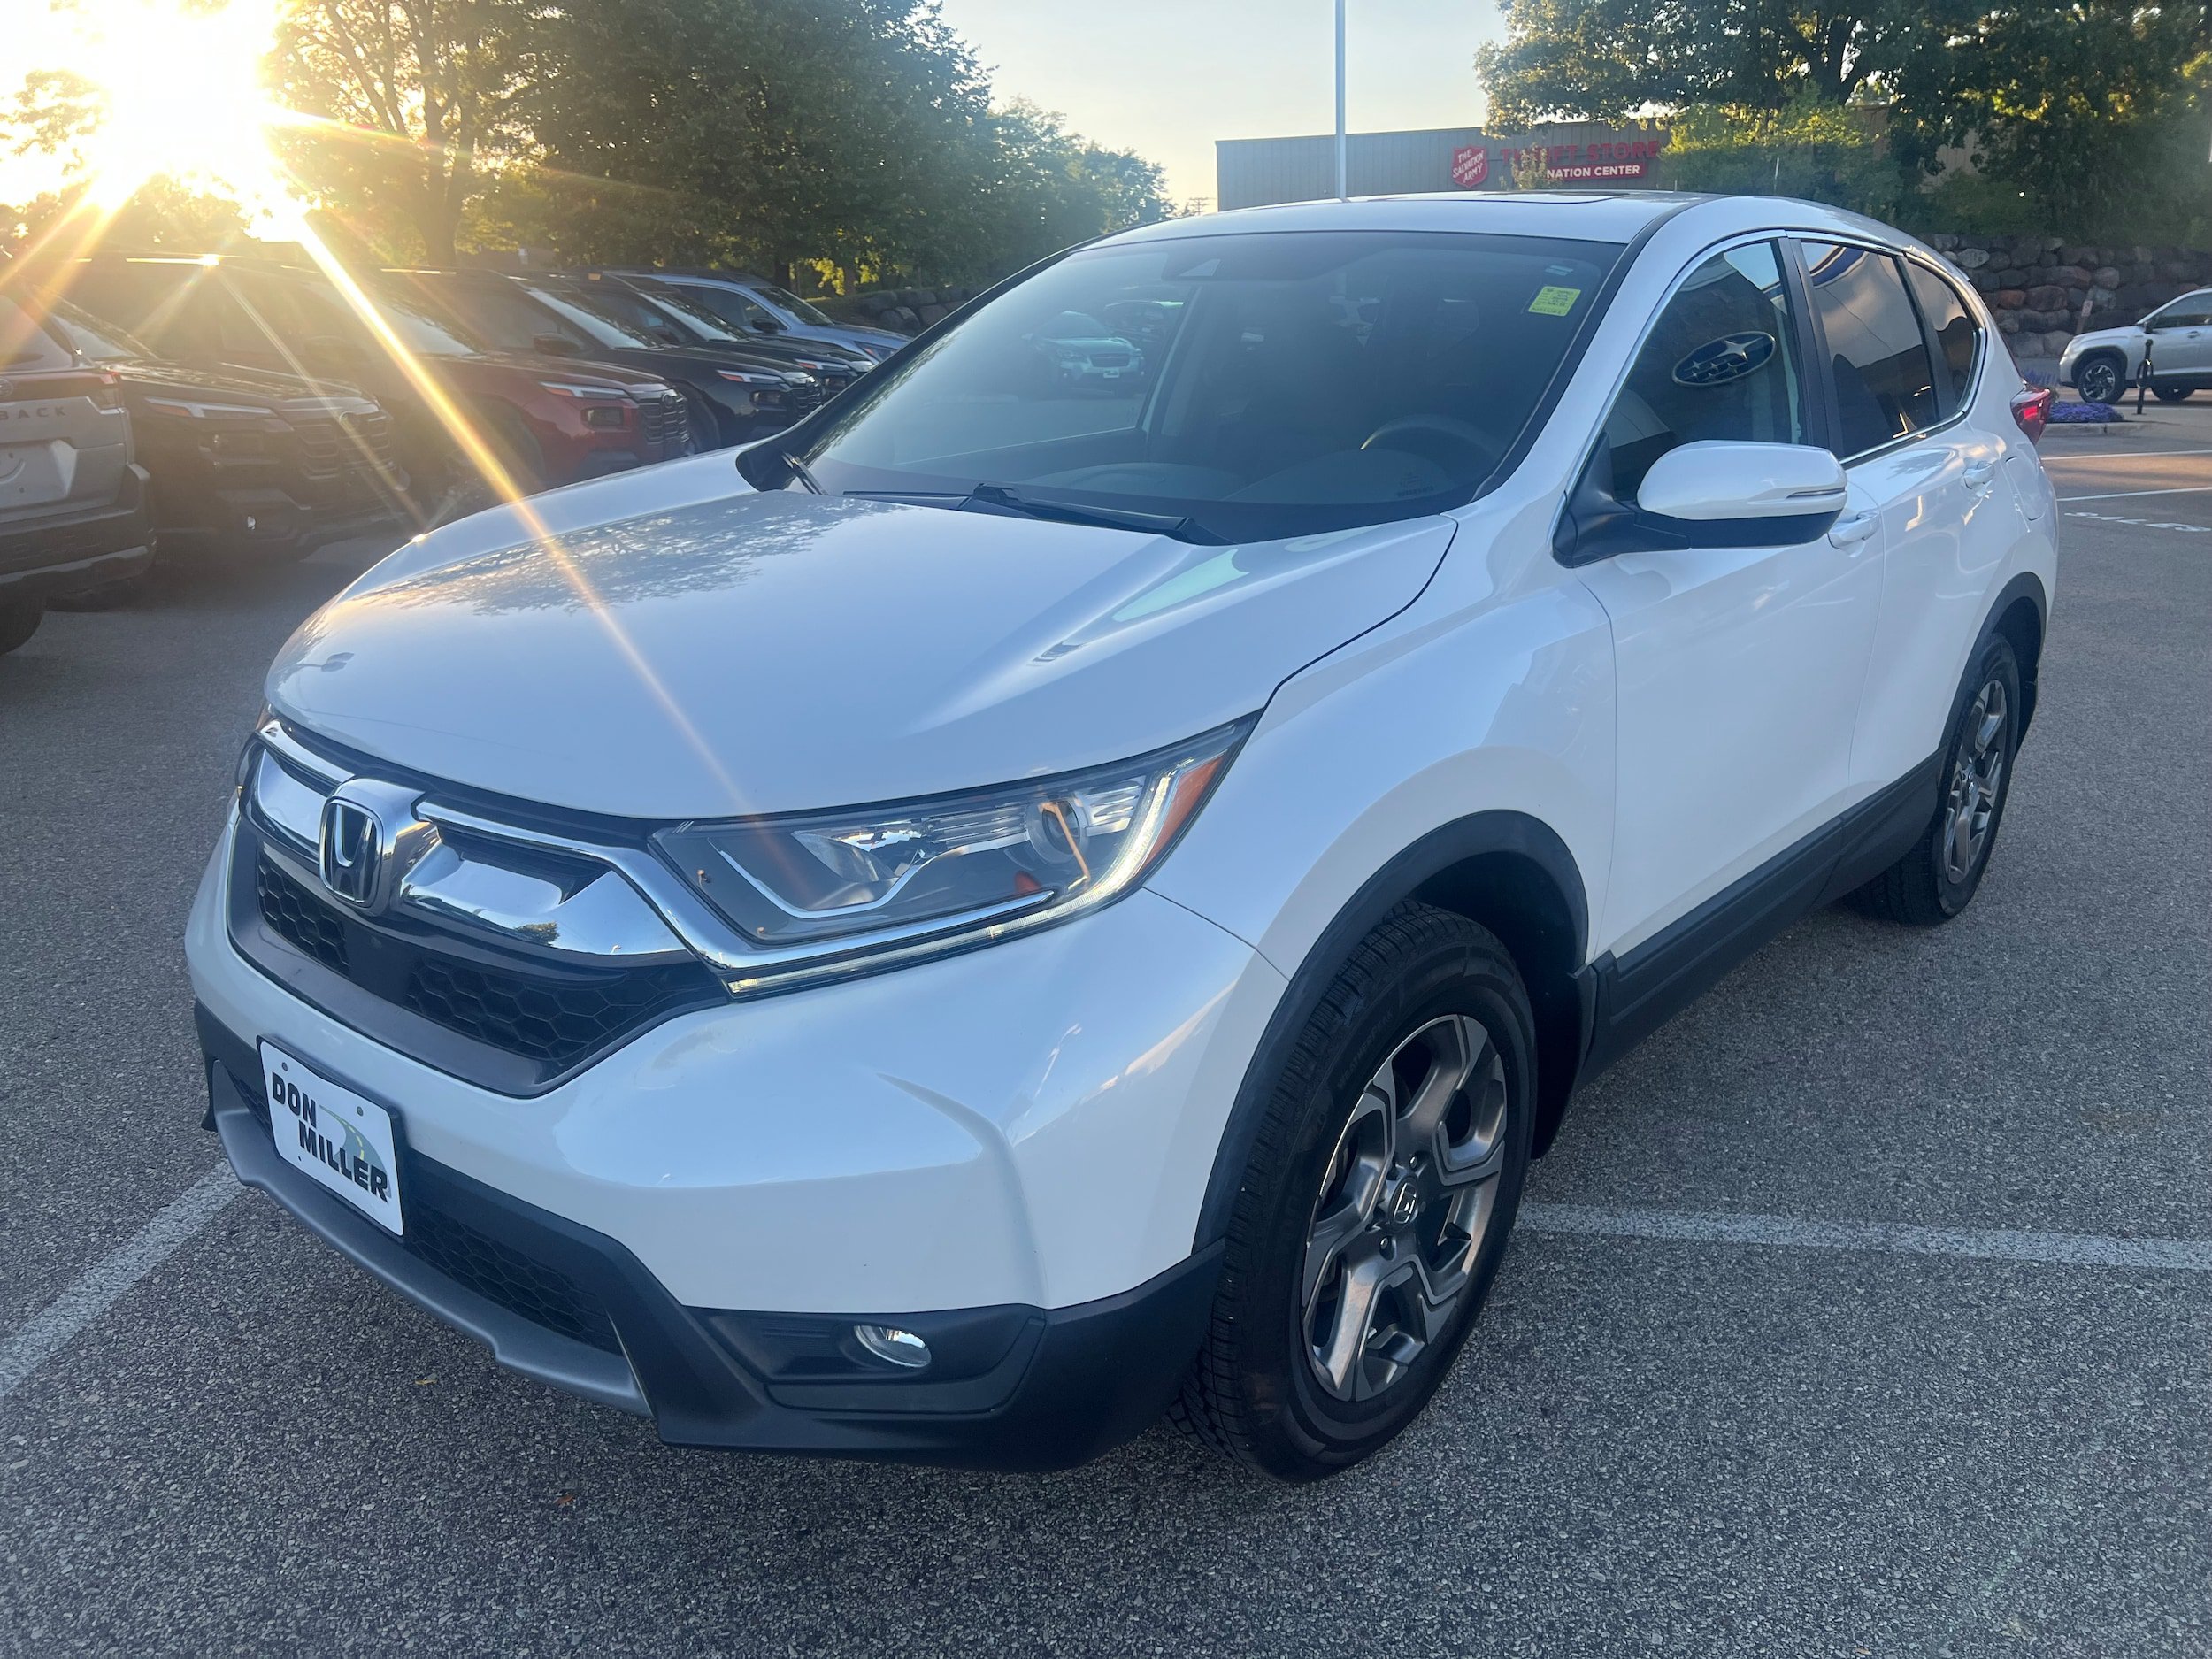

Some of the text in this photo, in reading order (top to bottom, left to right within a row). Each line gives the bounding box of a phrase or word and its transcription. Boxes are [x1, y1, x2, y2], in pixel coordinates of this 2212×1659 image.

[1458, 149, 1472, 163] THE
[1586, 140, 1660, 161] STORE
[1453, 150, 1484, 179] SALVATION
[1463, 163, 1484, 184] ARMY
[1546, 165, 1640, 180] NATION CENTER
[272, 1071, 317, 1128] DON
[298, 1119, 389, 1203] MILLER
